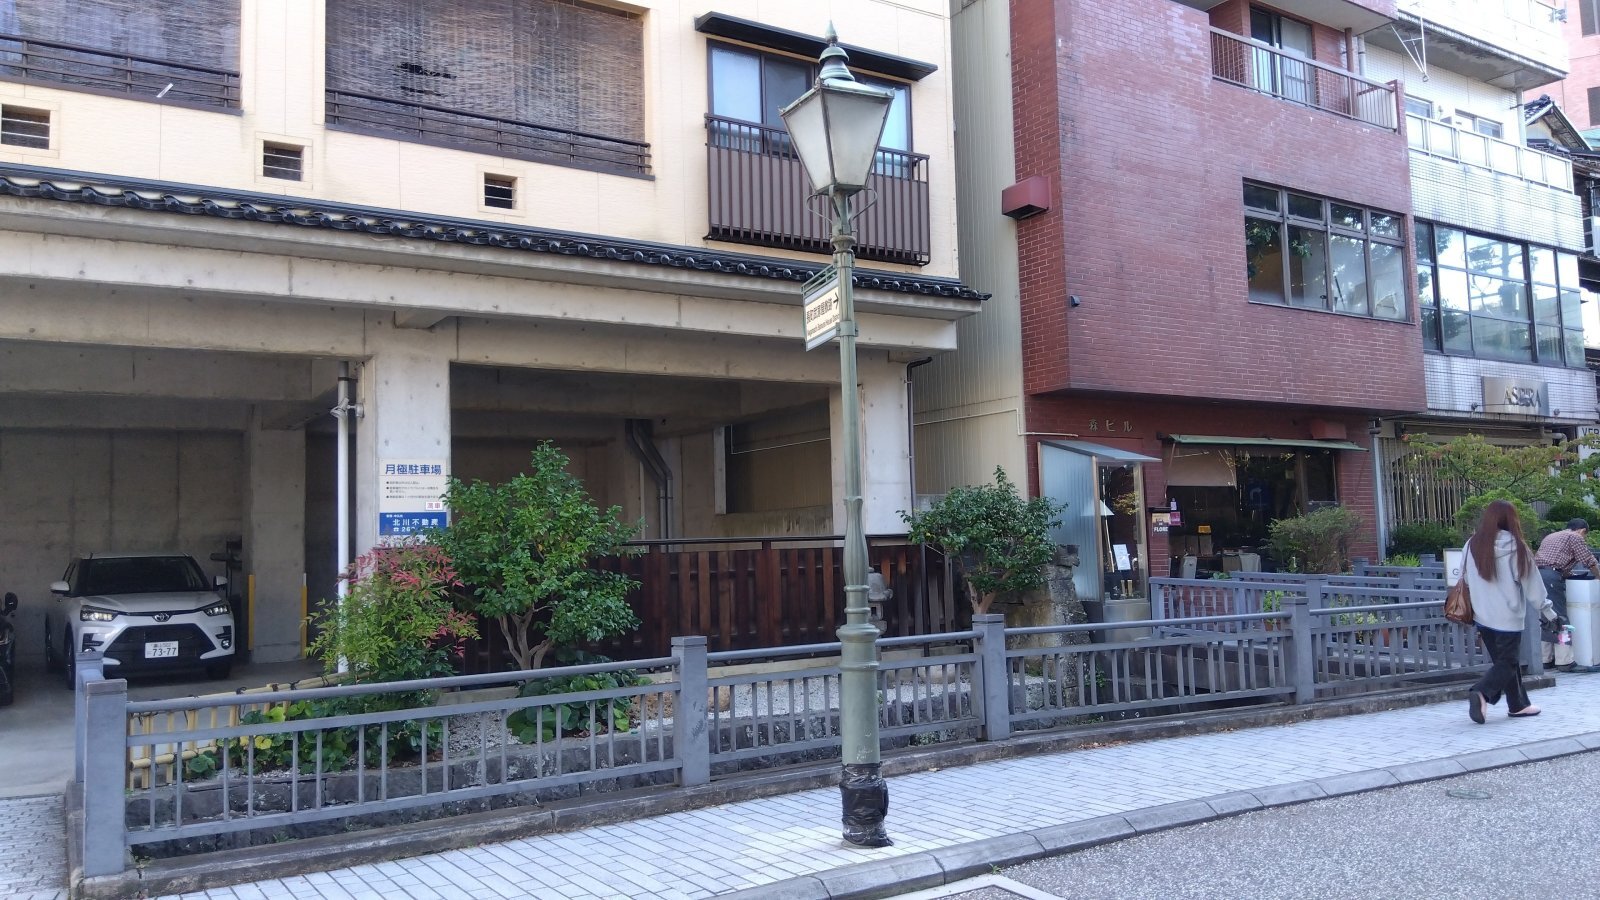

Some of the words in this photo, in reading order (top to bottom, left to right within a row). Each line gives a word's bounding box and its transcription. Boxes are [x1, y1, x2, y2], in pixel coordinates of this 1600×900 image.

[385, 464, 441, 475] 月極駐車場
[392, 518, 439, 526] 北川不動産
[152, 647, 177, 656] 73-77
